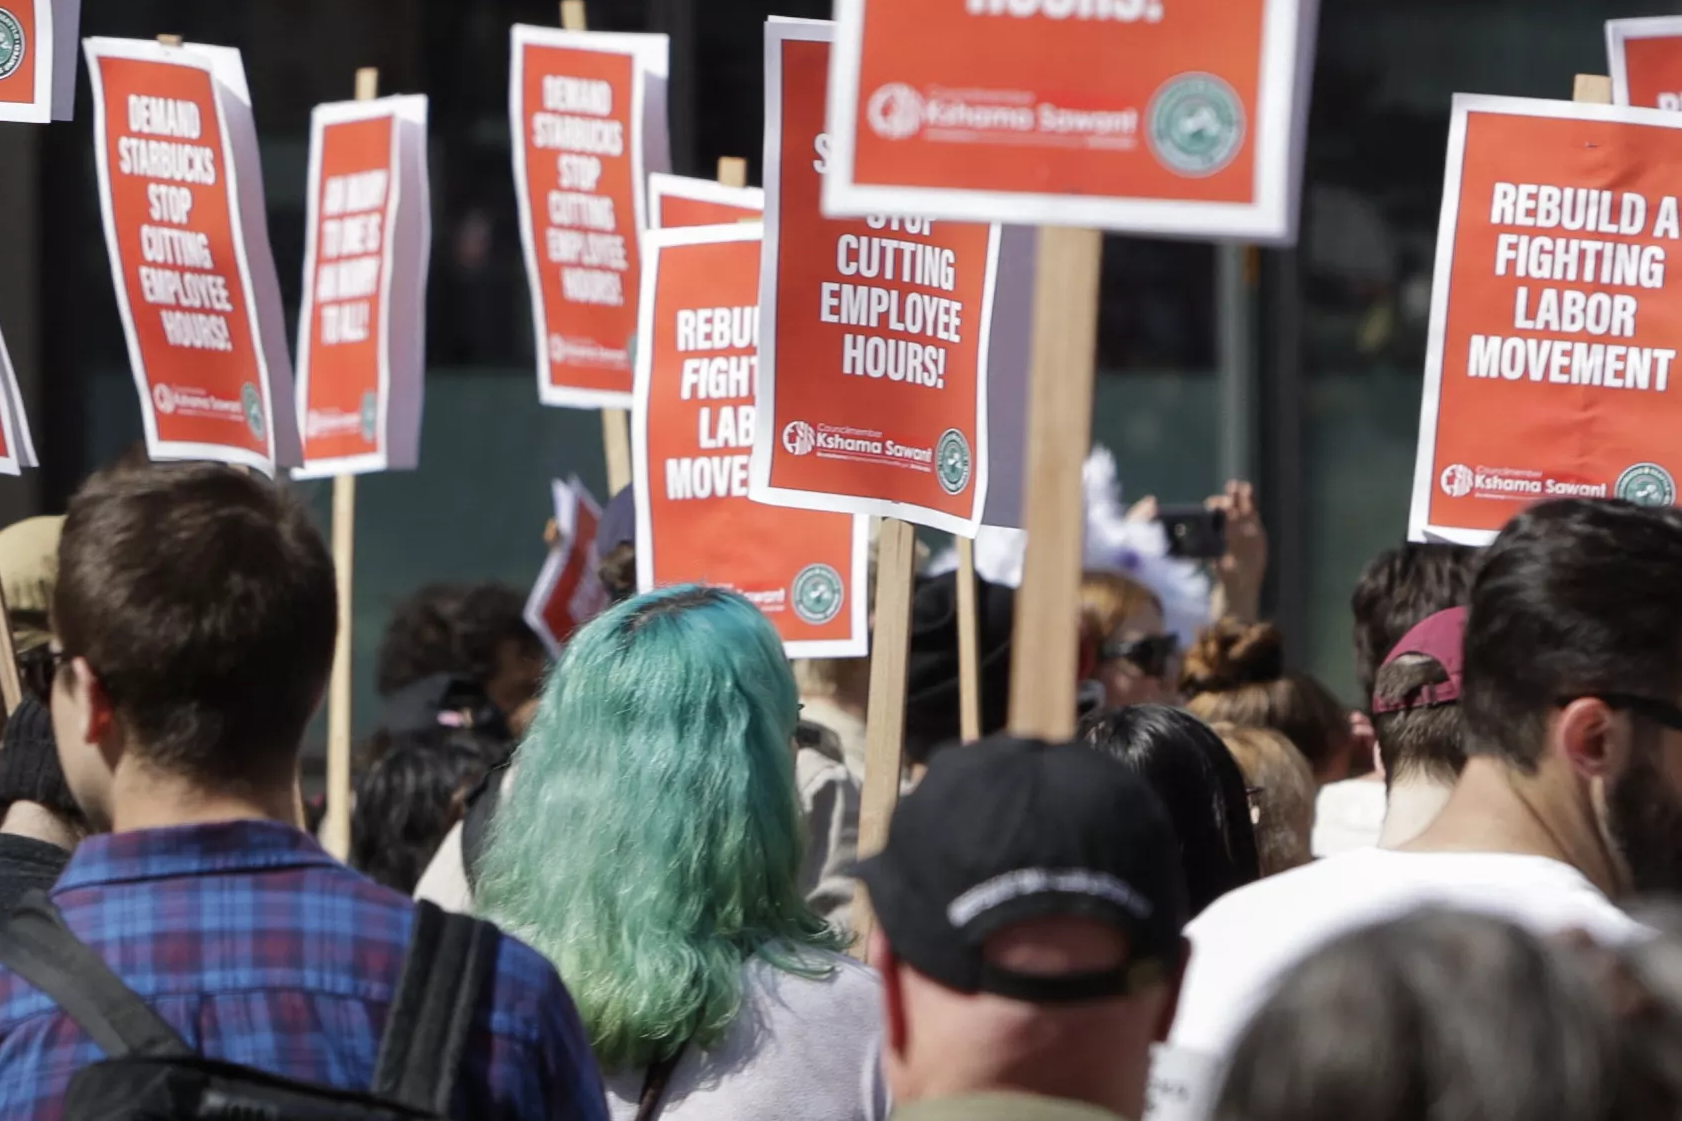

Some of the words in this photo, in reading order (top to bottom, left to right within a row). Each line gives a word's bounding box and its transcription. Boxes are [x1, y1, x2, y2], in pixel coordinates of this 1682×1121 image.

[129, 95, 200, 139] DEMAND
[544, 76, 611, 115] DEMAND
[534, 113, 622, 155] STARBUCKS
[119, 137, 215, 185] STARBUCKS
[559, 154, 600, 190] STOP
[148, 183, 191, 223] STOP
[549, 191, 614, 230] CUTTING
[1491, 183, 1645, 234] REBUILD
[1653, 196, 1679, 239] A
[141, 225, 212, 268] CUTTING
[547, 228, 627, 269] EMPLOYEE
[838, 235, 955, 291] CUTTING
[1496, 234, 1664, 288] FIGHTING
[139, 266, 232, 311] EMPLOYEE
[562, 268, 622, 304] HOURS!
[161, 310, 232, 350] HOURS!
[821, 282, 962, 343] EMPLOYEE
[1515, 287, 1636, 336] LABOR
[844, 334, 945, 388] HOURS!
[1468, 335, 1675, 390] MOVEMENT
[817, 433, 882, 454] Kshama
[885, 441, 933, 462] Sawant
[1475, 475, 1541, 493] Kshama
[1546, 479, 1607, 497] Sawant
